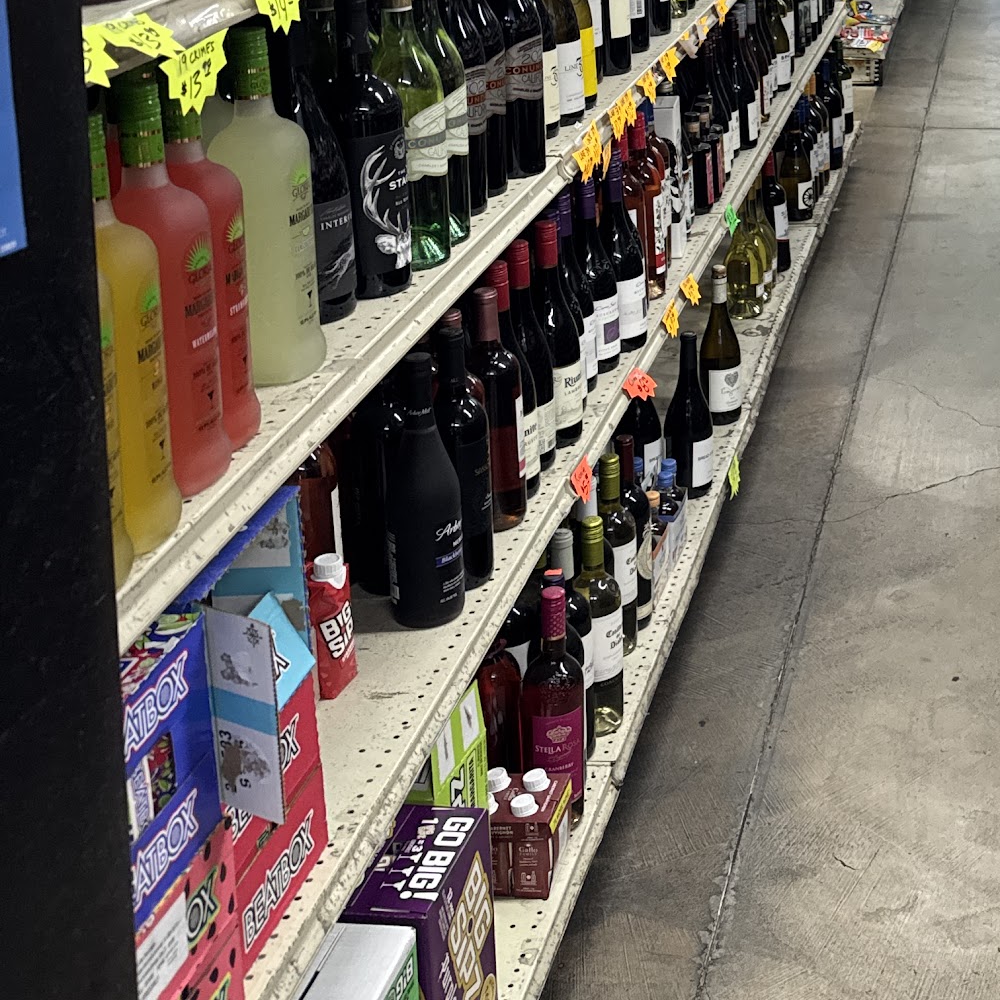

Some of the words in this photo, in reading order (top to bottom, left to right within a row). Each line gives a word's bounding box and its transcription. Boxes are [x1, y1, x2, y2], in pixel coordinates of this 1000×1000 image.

[189, 41, 215, 65] CRIMES
[564, 372, 582, 389] Riun
[320, 600, 352, 642] BIG
[327, 619, 355, 659] SIP
[125, 651, 190, 763] ATBOX
[535, 744, 561, 754] STELLA
[131, 788, 200, 913] ATBOX
[433, 815, 475, 848] GO
[518, 845, 539, 855] Gallo
[242, 808, 315, 954] BEATBOX
[399, 850, 456, 903] BIG!
[464, 857, 494, 952] BIG
